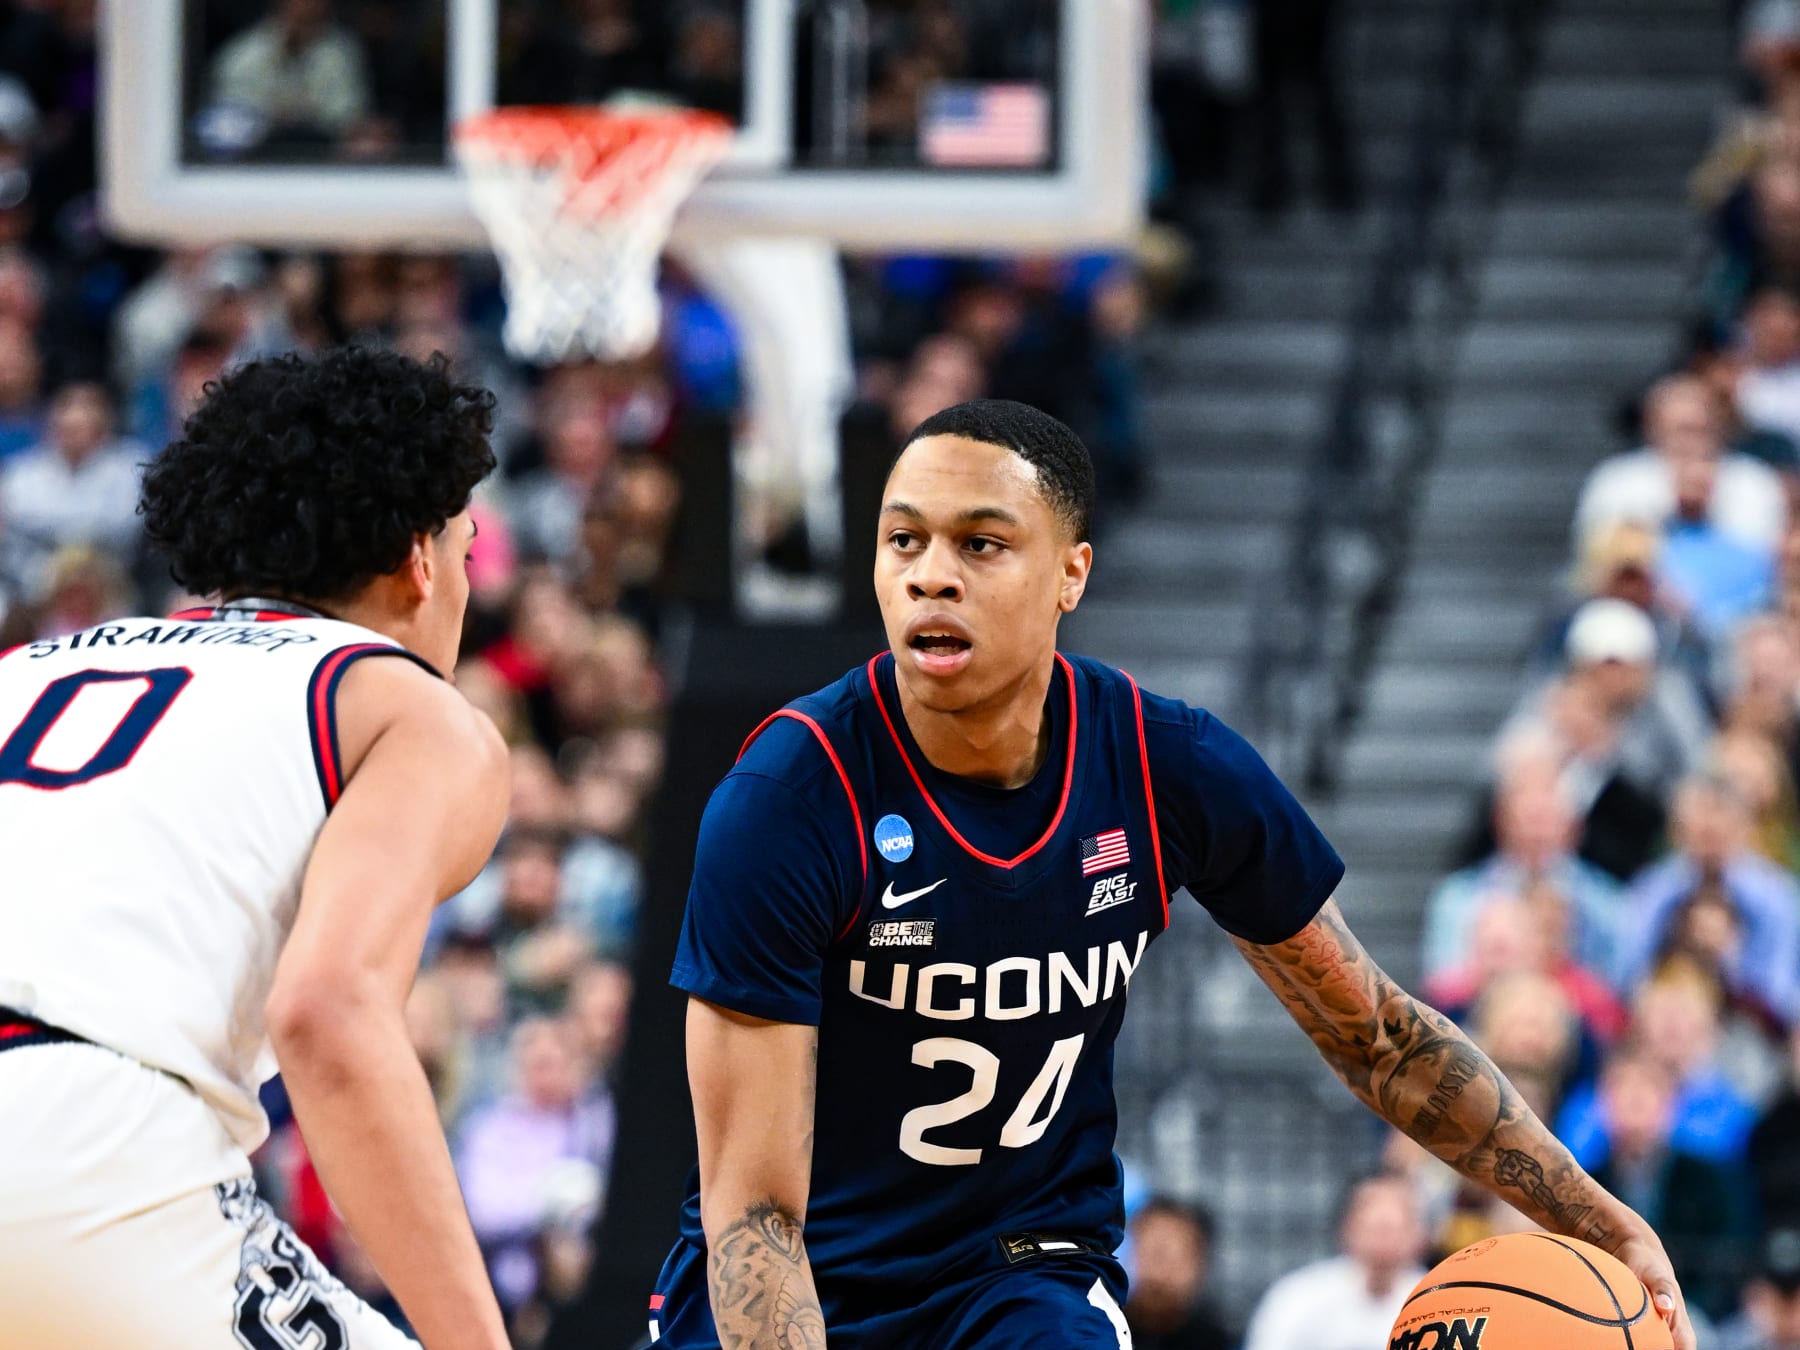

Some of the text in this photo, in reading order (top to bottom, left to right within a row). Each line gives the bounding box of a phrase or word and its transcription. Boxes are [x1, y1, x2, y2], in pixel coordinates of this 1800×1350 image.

[0, 666, 195, 791] 0
[881, 835, 914, 853] NCAA
[1088, 882, 1138, 909] EAST
[1092, 872, 1128, 896] BIG
[869, 936, 934, 946] CHANGE
[849, 930, 1148, 1021] UCONN
[899, 1032, 1085, 1166] 24
[1438, 1306, 1491, 1317] OFFICIAL
